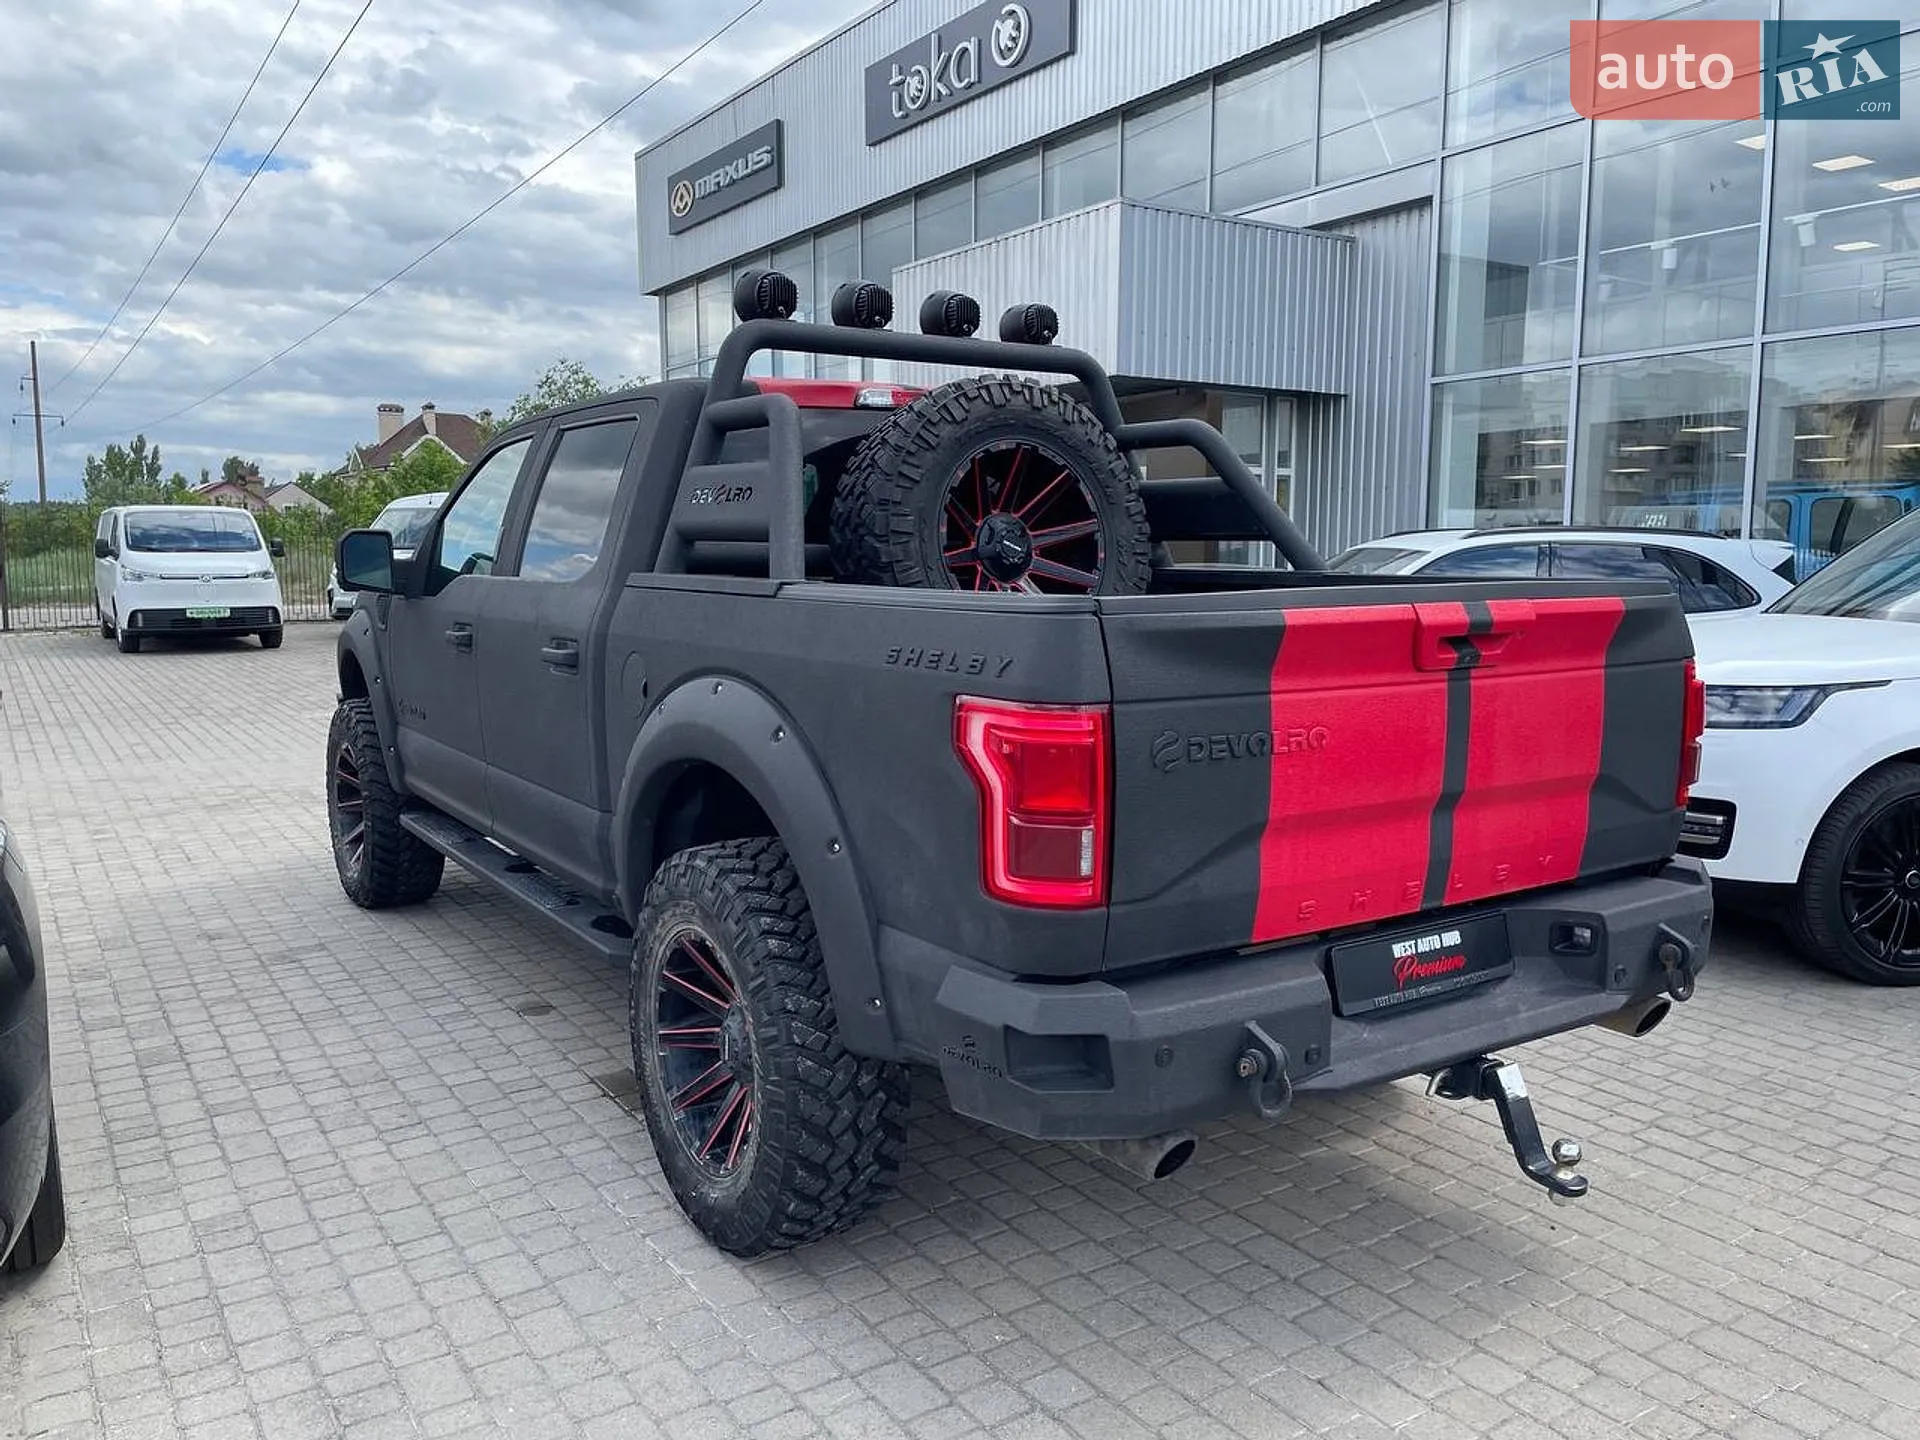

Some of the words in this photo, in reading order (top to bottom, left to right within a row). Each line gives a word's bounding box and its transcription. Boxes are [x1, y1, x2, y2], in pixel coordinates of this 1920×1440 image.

[885, 646, 1013, 679] SHELBY
[1187, 725, 1331, 763] DEVOLRO
[1392, 940, 1416, 958] WEST
[1417, 935, 1441, 954] AUTO
[1393, 953, 1467, 991] Premium
